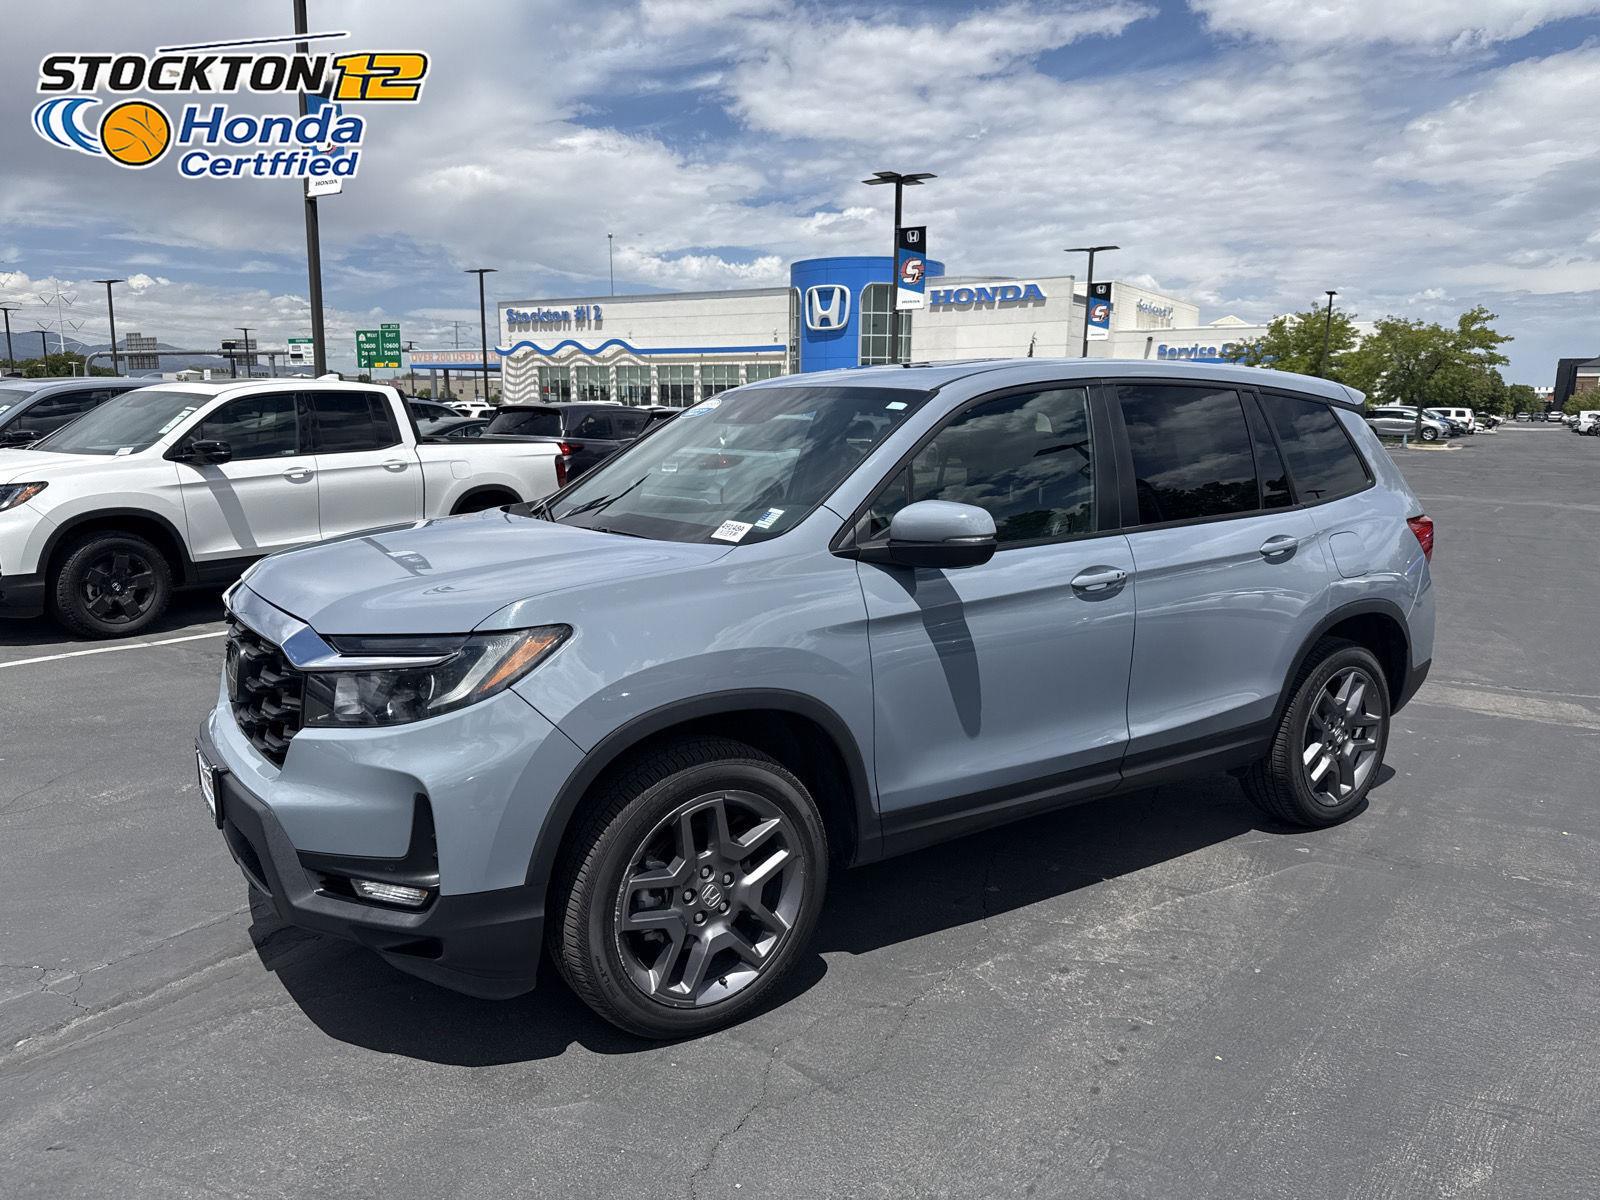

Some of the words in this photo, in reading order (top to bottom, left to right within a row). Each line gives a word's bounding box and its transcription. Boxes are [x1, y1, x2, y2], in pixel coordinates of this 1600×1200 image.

[929, 284, 1046, 305] HONDA
[506, 308, 571, 323] Stockton
[574, 304, 602, 321] #12
[411, 353, 433, 362] OVER
[435, 353, 452, 362] 200
[453, 352, 476, 361] USED
[1158, 344, 1217, 356] Service
